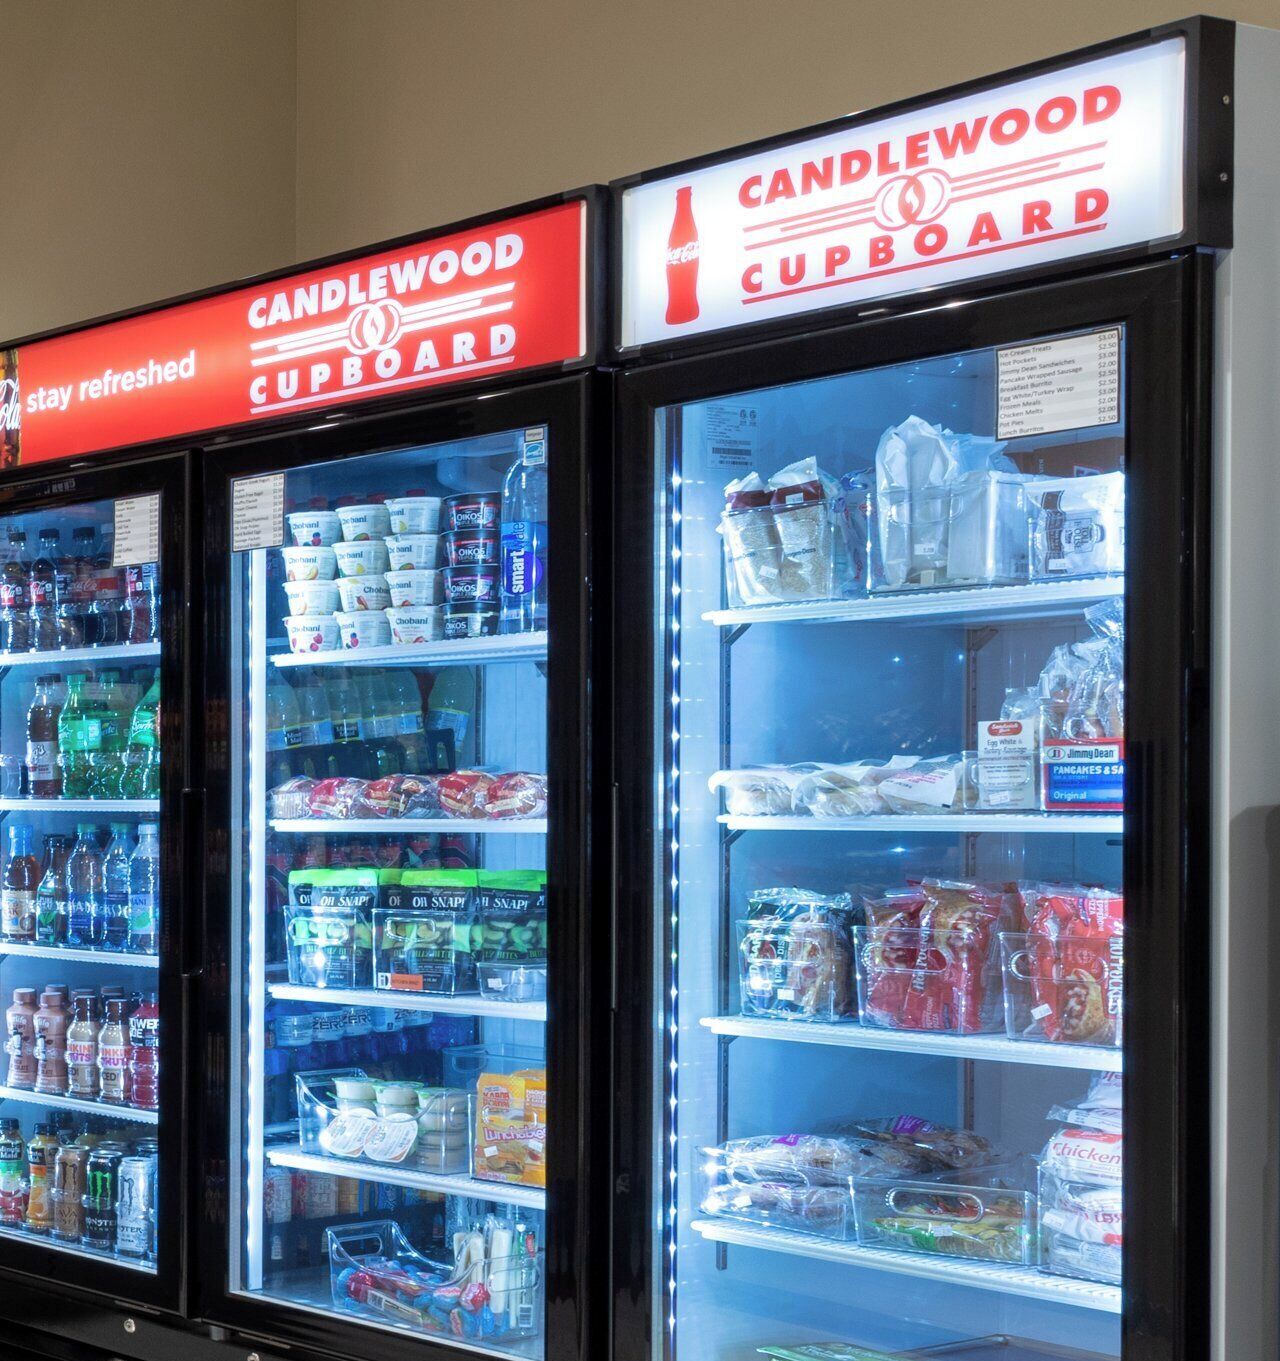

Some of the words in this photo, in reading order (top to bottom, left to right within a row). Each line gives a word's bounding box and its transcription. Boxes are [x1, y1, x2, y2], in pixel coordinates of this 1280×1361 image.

[738, 84, 1122, 209] CANDLEWOOD
[741, 187, 1110, 294] CUPBOARD
[247, 233, 525, 330] CANDLEWOOD
[248, 323, 519, 406] CUPBOARD
[27, 383, 72, 416] stay
[79, 350, 196, 402] refreshed
[456, 513, 482, 521] OIKOS
[458, 548, 485, 556] OIKOS
[451, 584, 476, 592] OIKOS
[396, 617, 428, 625] Chobani
[1068, 749, 1093, 759] Jimmy
[1094, 749, 1114, 758] Dean
[1053, 766, 1102, 775] PANCAKES
[1103, 766, 1110, 775] &
[1053, 791, 1087, 801] Original
[320, 896, 334, 906] OH
[338, 896, 369, 906] SNAP!
[431, 897, 465, 908] SNAP!
[494, 898, 528, 910] SNAP!
[1053, 1142, 1121, 1164] Chicken
